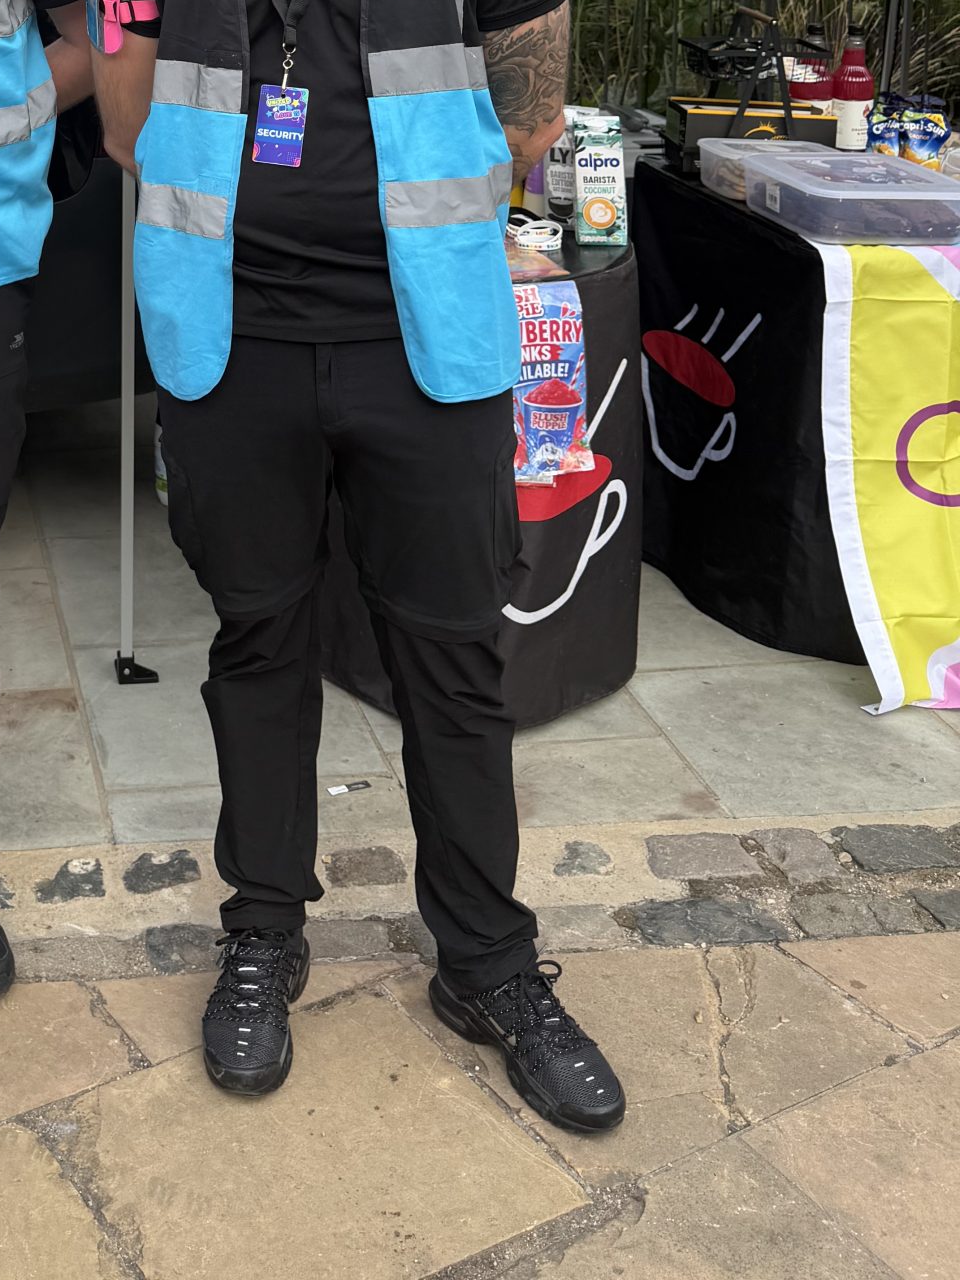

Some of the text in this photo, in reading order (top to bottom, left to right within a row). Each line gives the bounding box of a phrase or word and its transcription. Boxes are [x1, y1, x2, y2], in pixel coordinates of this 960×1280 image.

[257, 128, 304, 141] SECURITY
[578, 153, 620, 171] alpro
[583, 176, 616, 184] BARISTA
[584, 186, 616, 194] COCONUT
[520, 320, 583, 343] BERRY
[521, 345, 551, 361] NKS
[520, 363, 569, 381] ILABLE!
[532, 411, 568, 421] SLUSH
